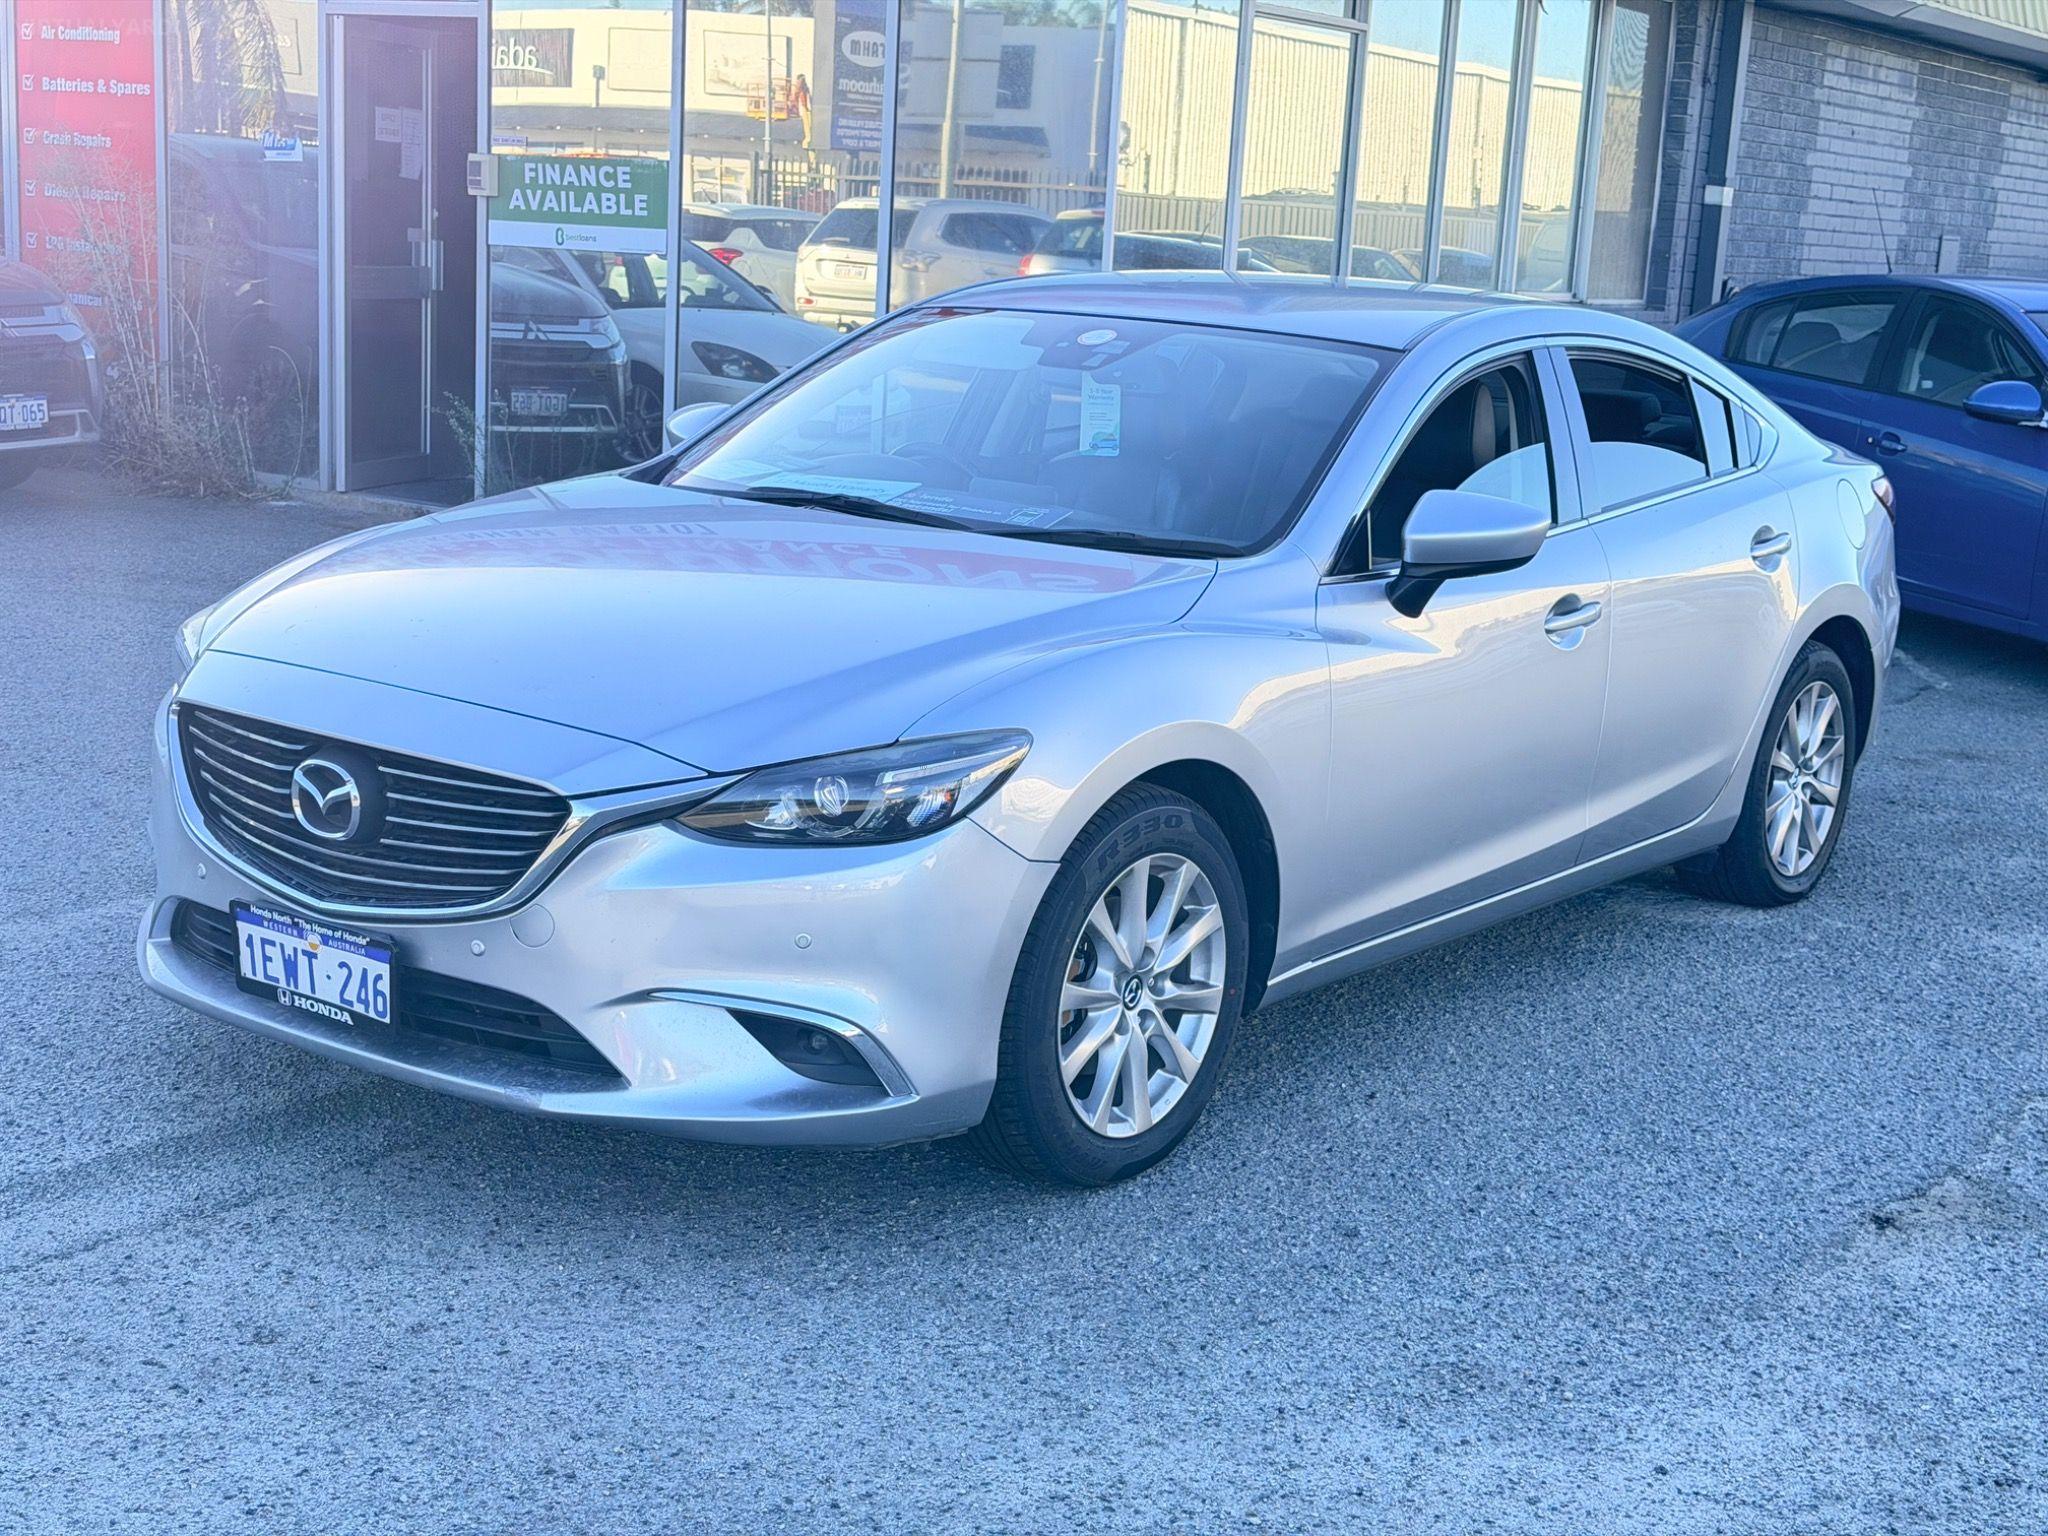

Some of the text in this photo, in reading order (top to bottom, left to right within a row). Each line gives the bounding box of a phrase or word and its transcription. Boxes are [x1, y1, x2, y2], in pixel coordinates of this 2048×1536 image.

[41, 25, 120, 44] Air Conditioning
[42, 76, 151, 96] Batteries & Spares
[43, 131, 112, 149] Crash Repairs
[524, 162, 632, 188] FINANCE
[509, 189, 648, 216] AVAILABLE
[565, 232, 597, 243] bestloans
[250, 904, 272, 919] Honda
[273, 911, 292, 925] North
[312, 925, 333, 937] Home
[334, 930, 342, 939] of
[263, 920, 366, 956] WESTERN AUSTRALIA
[294, 996, 354, 1026] HONDA
